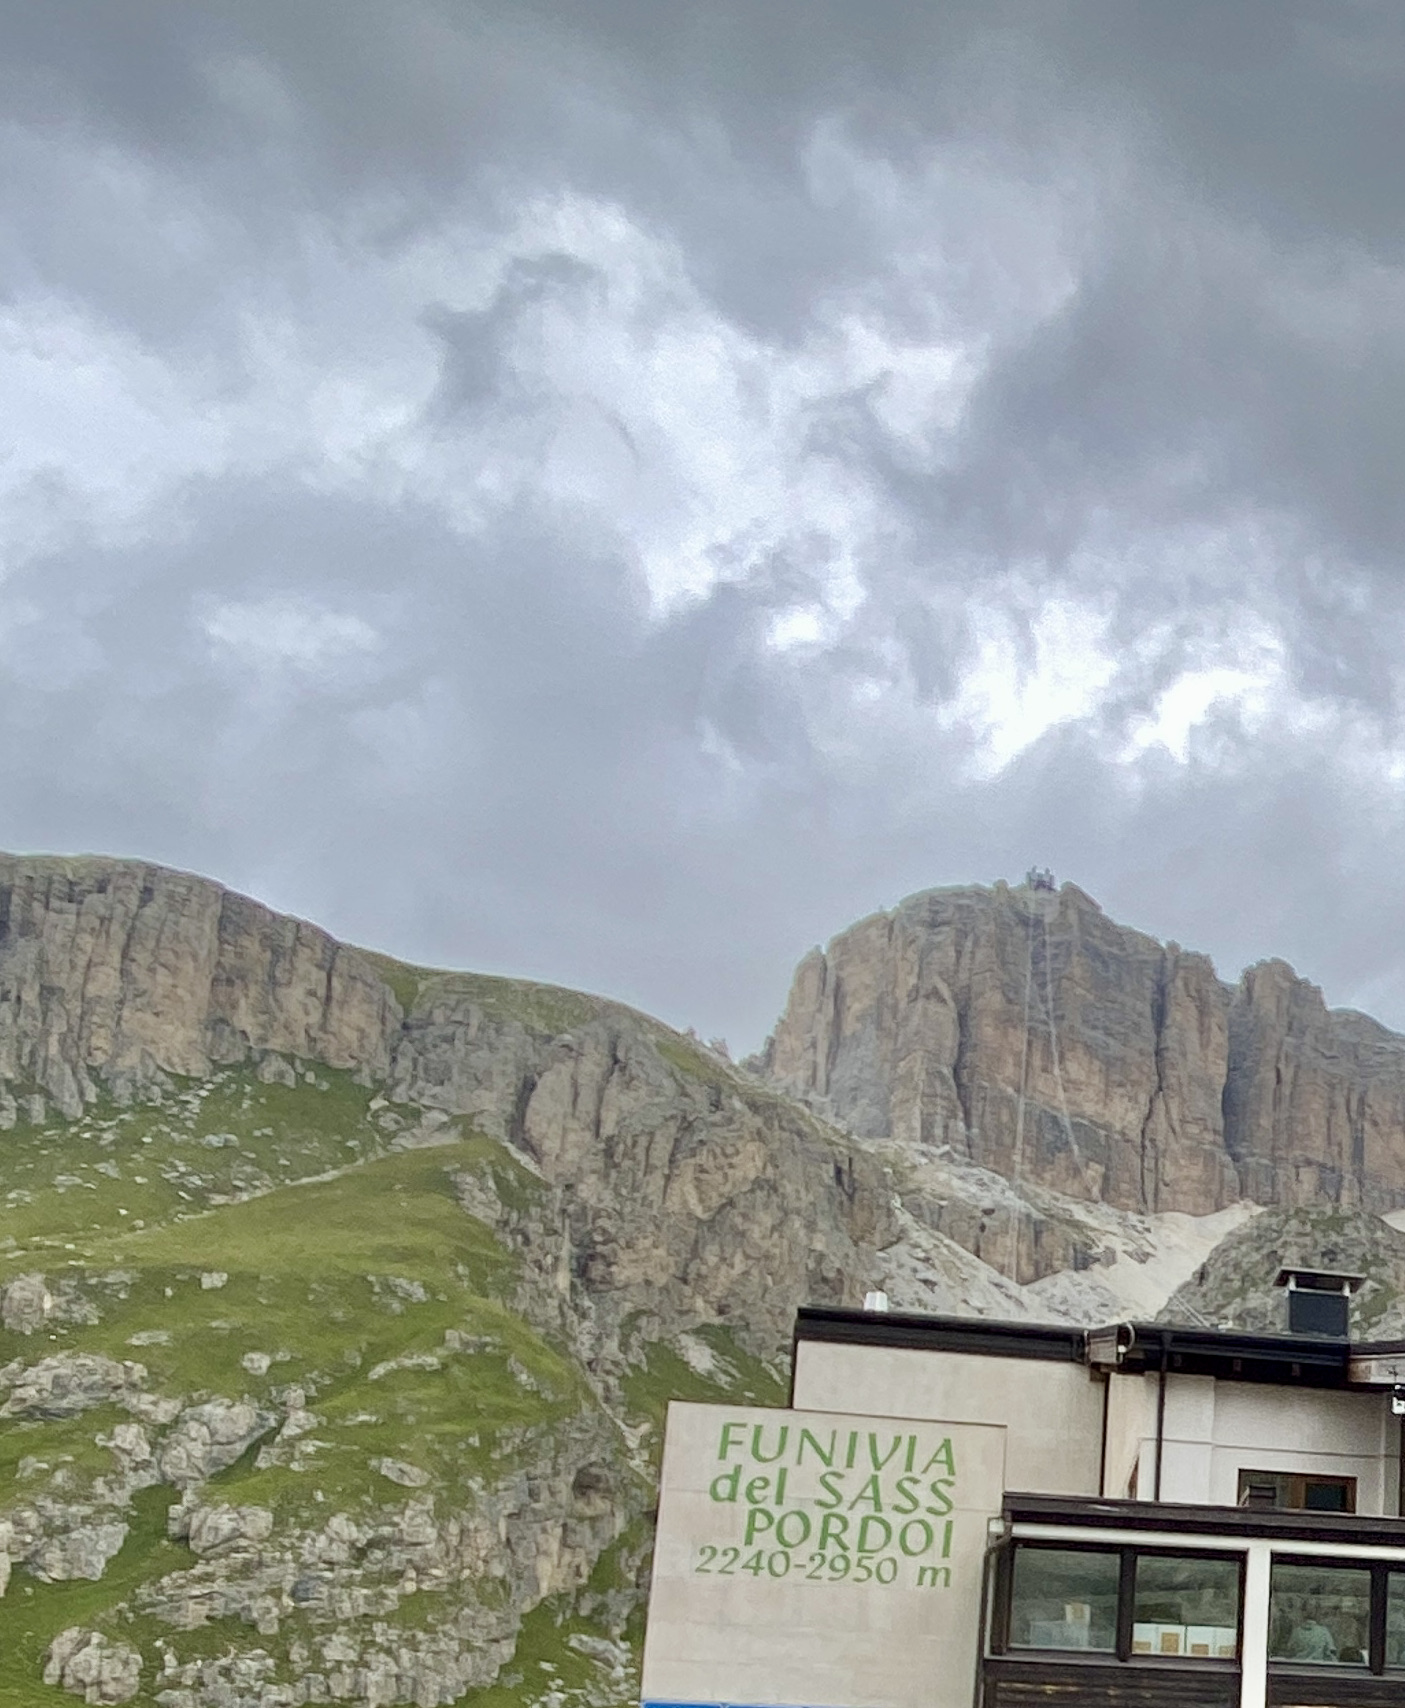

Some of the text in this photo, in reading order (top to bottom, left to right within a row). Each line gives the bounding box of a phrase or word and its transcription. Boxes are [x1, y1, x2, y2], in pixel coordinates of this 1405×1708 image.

[717, 1421, 957, 1477] FUNIVIA
[709, 1464, 956, 1517] del SASS
[743, 1507, 954, 1559] PORDOI
[694, 1545, 951, 1588] 2240-2950 m
